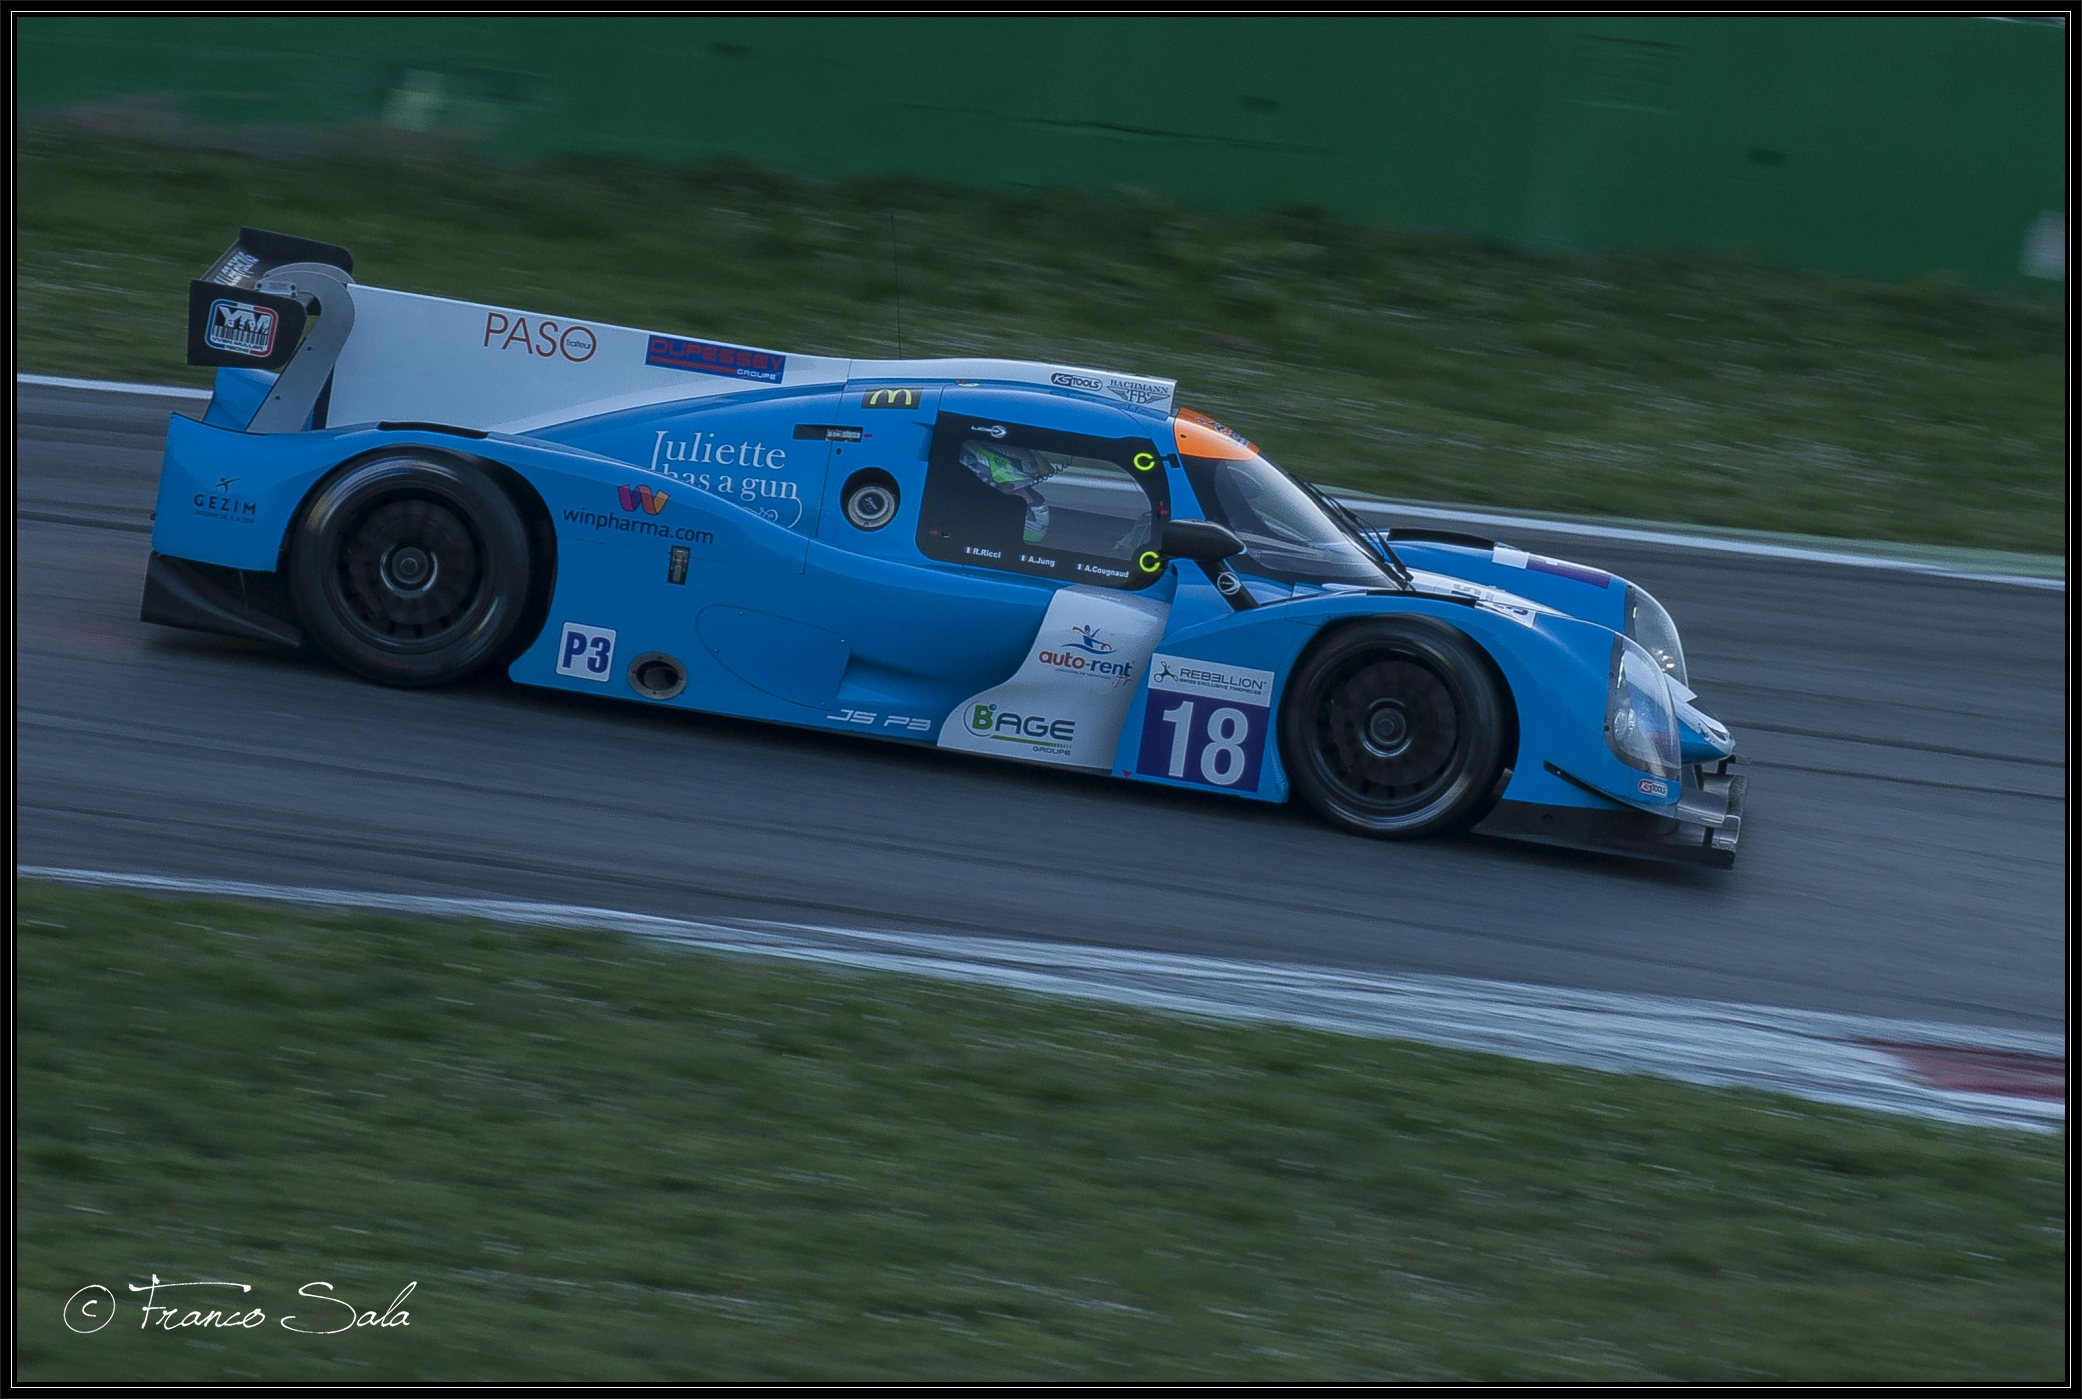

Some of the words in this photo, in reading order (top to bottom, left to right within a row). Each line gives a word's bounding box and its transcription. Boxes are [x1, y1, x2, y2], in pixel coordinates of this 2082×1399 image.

[483, 311, 597, 363] PASO
[649, 337, 784, 371] DUPESSEY
[736, 368, 777, 380] GROUPE
[1109, 379, 1170, 395] BACHMANN
[650, 430, 786, 471] Juliette
[717, 474, 734, 494] a
[740, 476, 802, 502] gun
[193, 493, 257, 516] GEZIM
[562, 507, 714, 545] winpharma.com
[561, 630, 612, 674] P3
[1038, 650, 1133, 678] auto-rent
[826, 708, 878, 725] JS
[883, 715, 932, 731] P3
[1032, 745, 1072, 757] GROUPE
[1162, 700, 1249, 786] 18
